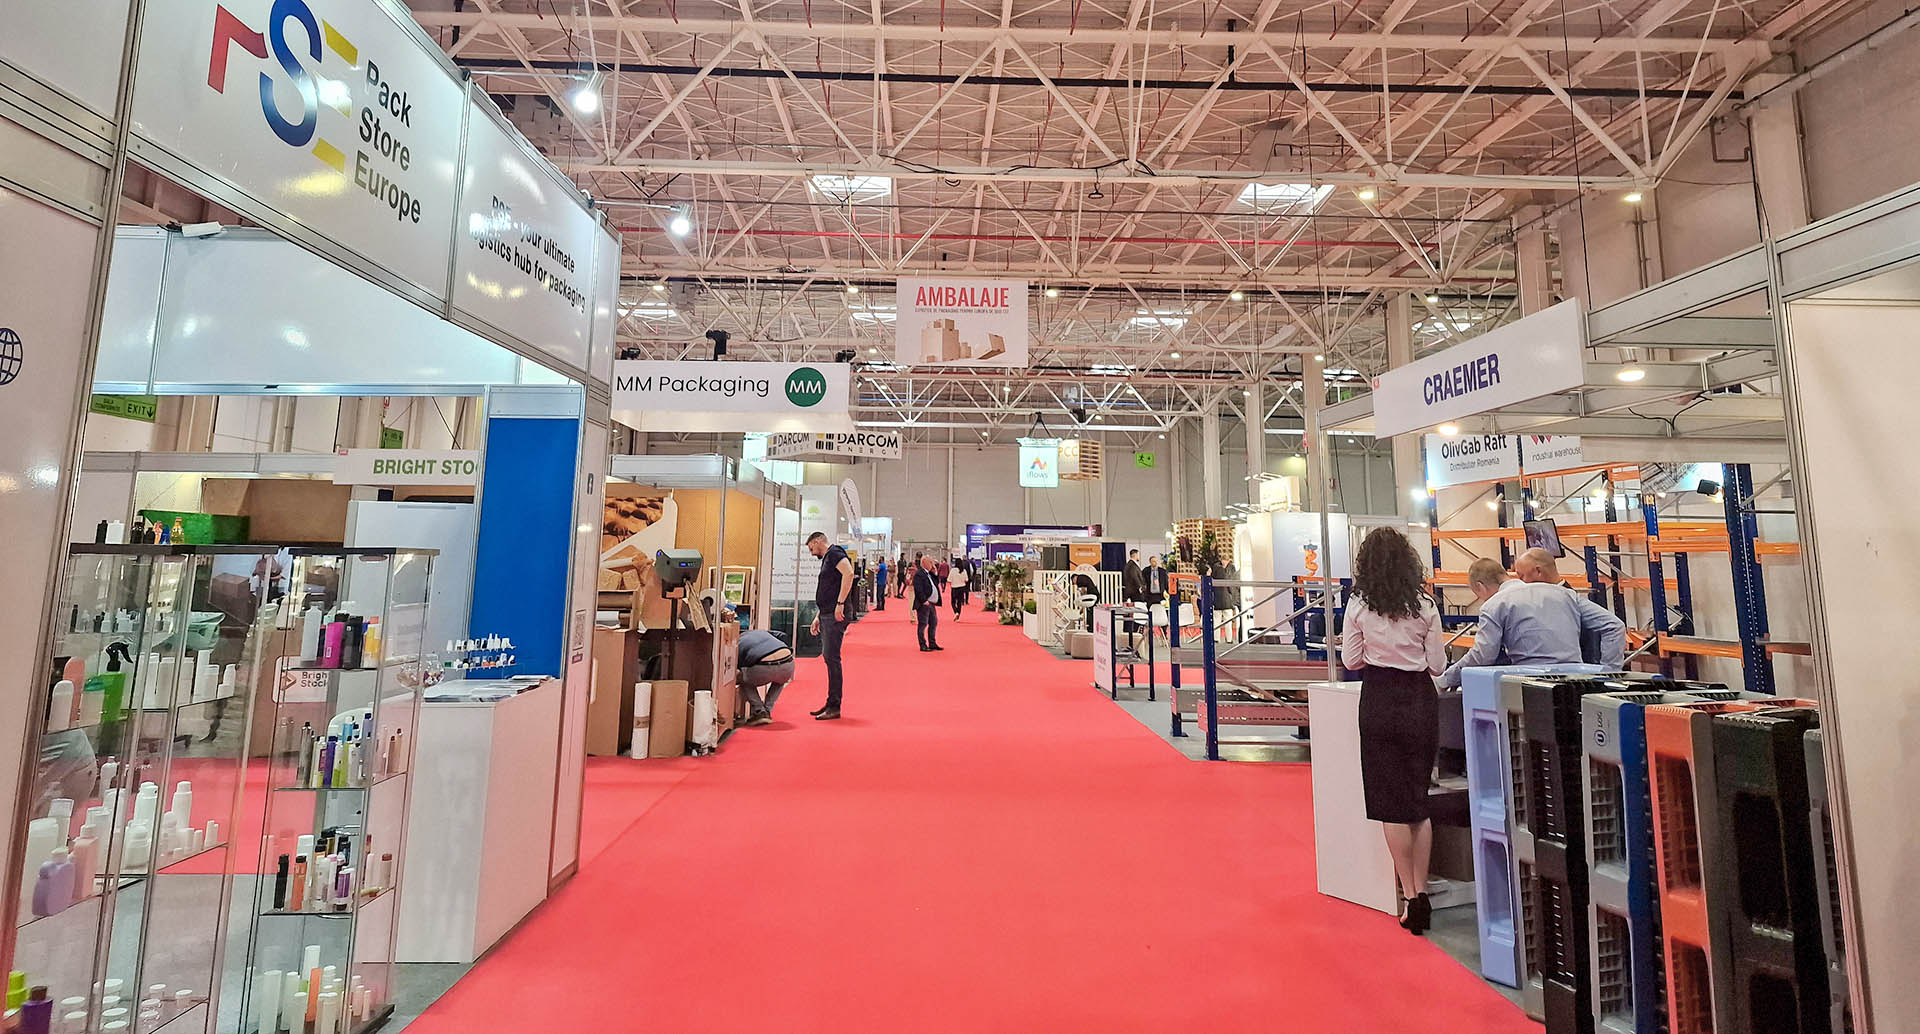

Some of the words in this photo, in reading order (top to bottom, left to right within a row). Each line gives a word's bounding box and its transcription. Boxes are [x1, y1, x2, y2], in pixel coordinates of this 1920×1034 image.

[366, 60, 412, 128] Pack
[359, 107, 410, 171] Store
[354, 150, 421, 223] Europe
[544, 239, 575, 273] ultimate
[514, 246, 532, 275] hub
[534, 260, 548, 284] for
[549, 274, 586, 313] packaging
[915, 286, 1010, 308] AMBALAJE
[616, 376, 652, 392] MM
[659, 375, 770, 398] Packaging
[789, 380, 822, 394] MM
[1423, 353, 1501, 406] CRAEMER
[127, 403, 145, 416] EXIT
[778, 432, 810, 448] DARCOM
[836, 445, 898, 456] ENERGY
[837, 432, 898, 449] DARCOM
[1441, 437, 1481, 459] OlivGab
[1484, 434, 1507, 452] Raft
[373, 459, 437, 475] BRIGHT
[442, 460, 478, 475] STO
